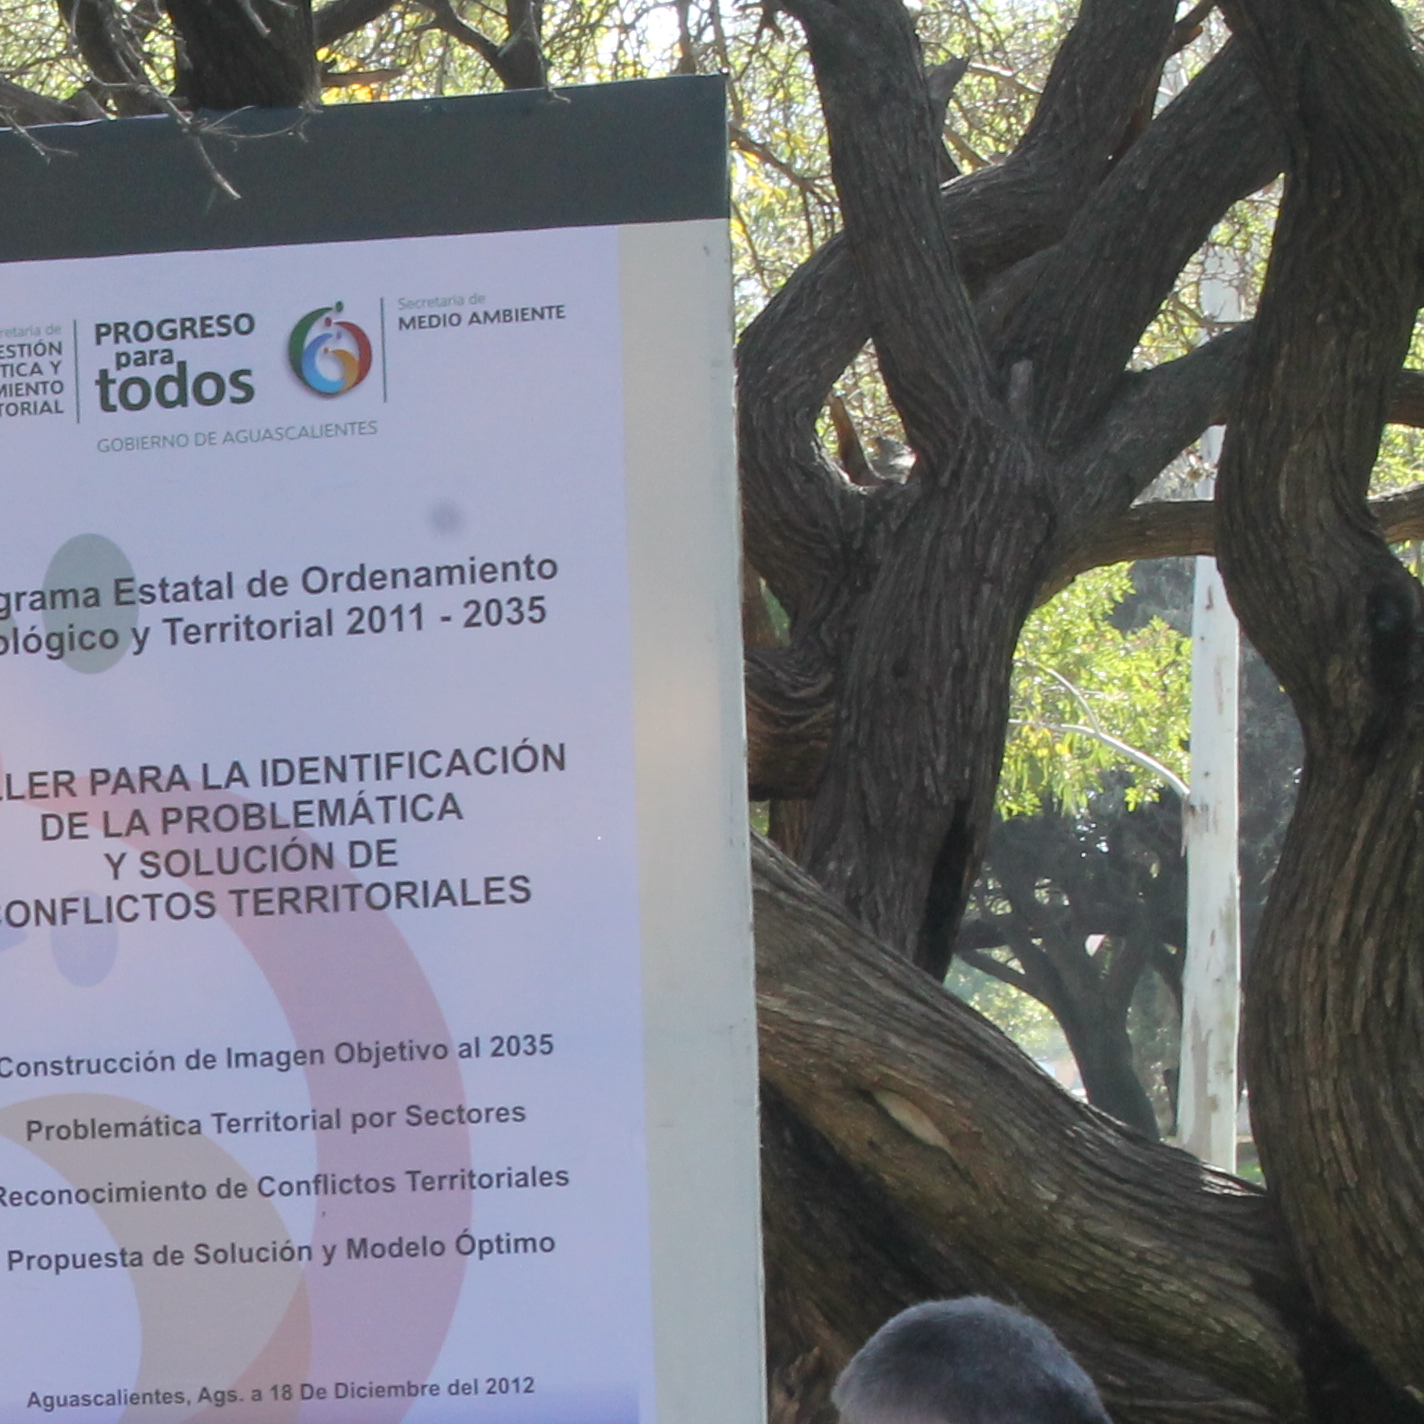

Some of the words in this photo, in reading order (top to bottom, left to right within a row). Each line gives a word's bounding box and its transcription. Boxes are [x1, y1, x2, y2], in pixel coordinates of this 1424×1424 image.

[398, 312, 462, 331] MEDIO
[468, 304, 567, 326] AMBIENTE
[468, 293, 486, 306] de
[45, 323, 62, 336] de
[95, 312, 255, 346] PROGRESO
[50, 360, 62, 375] Y
[115, 348, 174, 370] para
[95, 360, 255, 413] todos
[97, 433, 190, 452] GOBIERNO
[194, 431, 218, 447] DE
[222, 420, 379, 445] AGUASCALIENTES
[112, 571, 234, 607] Estatal
[246, 568, 289, 599] de
[301, 553, 559, 595] Ordenamiento
[129, 626, 151, 656] y
[161, 607, 333, 646] Territorial
[346, 602, 423, 636] 2011
[463, 595, 547, 629] 2035
[89, 763, 192, 797] PARA
[201, 760, 250, 791] LA
[260, 737, 566, 788] IDENTIFICACIÓN
[40, 810, 90, 842] DE
[102, 808, 151, 838] LA
[157, 785, 464, 836] PROBLEMÁTICA
[103, 852, 127, 881] Y
[139, 835, 335, 879] SOLUCIÓN
[348, 838, 399, 869] DE
[227, 874, 532, 918] TERRITORIALES
[184, 1048, 217, 1071] de
[226, 1047, 326, 1073] Imagen
[334, 1039, 449, 1069] Objetivo
[457, 1036, 481, 1060] al
[490, 1033, 554, 1058] 2035
[26, 1114, 202, 1142] Problemática
[210, 1107, 342, 1135] Territorial
[351, 1110, 397, 1135] por
[404, 1103, 527, 1128] Sectores
[215, 1177, 248, 1200] de
[256, 1172, 397, 1199] Conflictos
[403, 1165, 570, 1193] Territoriales
[7, 1246, 144, 1276] Propuesta
[152, 1244, 185, 1267] de
[193, 1239, 313, 1266] Solución
[321, 1244, 337, 1267] y
[346, 1235, 446, 1260] Modelo
[454, 1227, 556, 1261] Óptimo
[26, 1388, 192, 1413] Aguascalientes,
[197, 1386, 245, 1409] Ags.
[250, 1388, 263, 1403] a
[269, 1383, 294, 1402] 18
[299, 1382, 328, 1401] De
[334, 1380, 441, 1400] Diciembre
[446, 1378, 479, 1397] del
[485, 1376, 535, 1396] 2012
